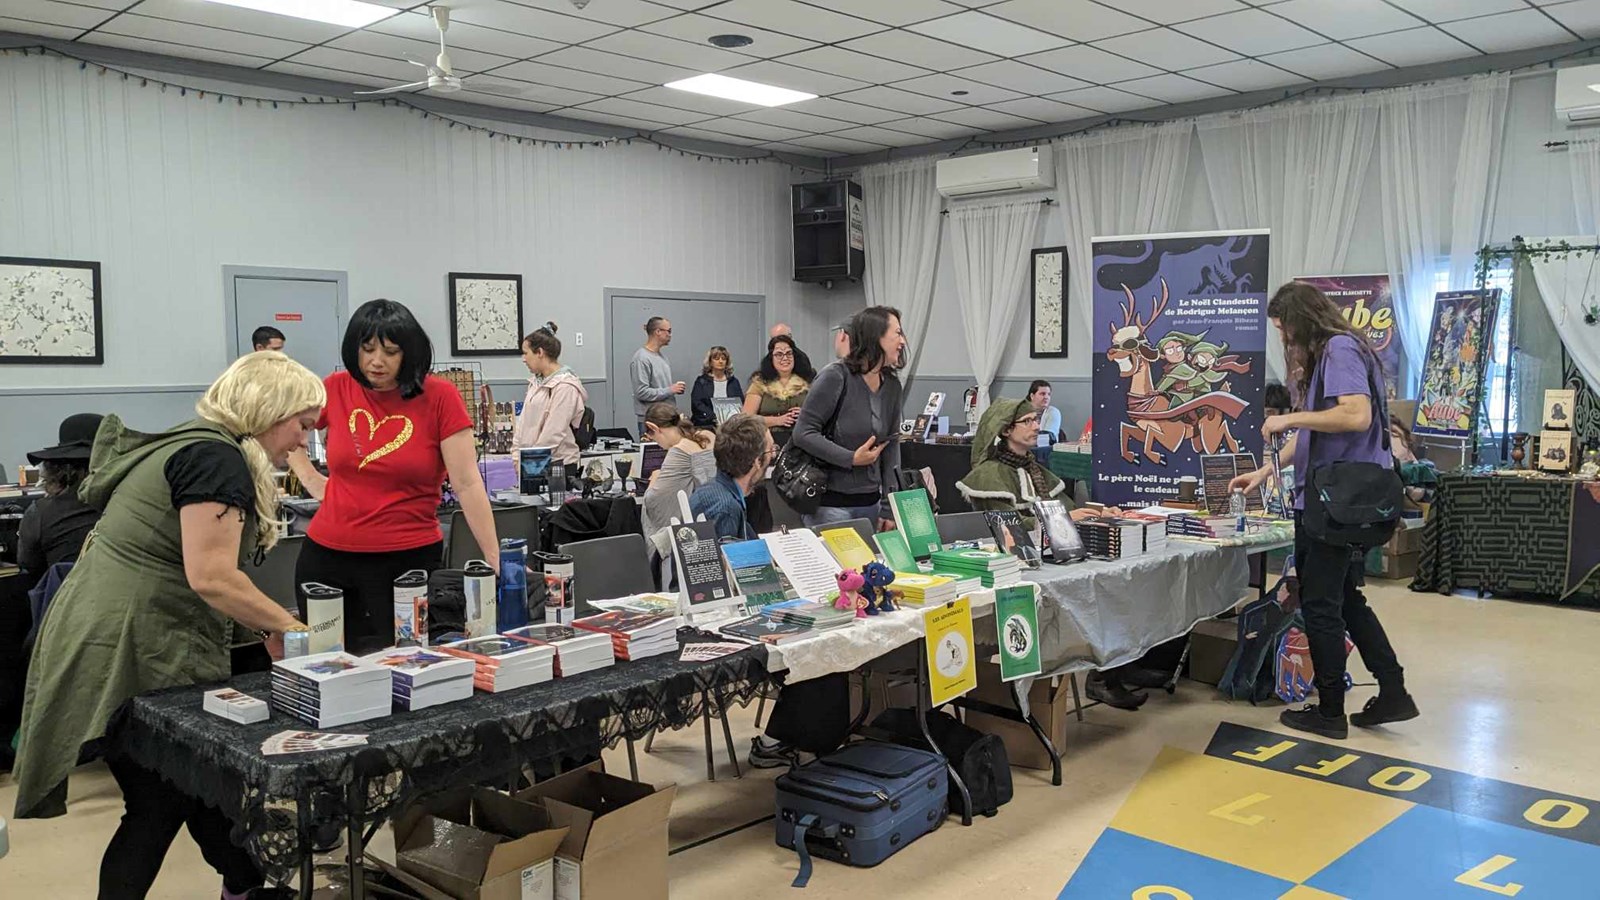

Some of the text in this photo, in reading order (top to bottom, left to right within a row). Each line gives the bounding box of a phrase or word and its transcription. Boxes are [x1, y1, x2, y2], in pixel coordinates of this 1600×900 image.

[1179, 297, 1259, 307] Le Noël Clandestin
[1164, 307, 1259, 317] de Rodrigue Melançon
[1342, 298, 1393, 330] be
[1098, 473, 1110, 481] Le
[1111, 474, 1133, 483] père
[1135, 474, 1157, 483] Noël
[1133, 485, 1179, 494] le cadeau
[1232, 740, 1432, 792] OFF
